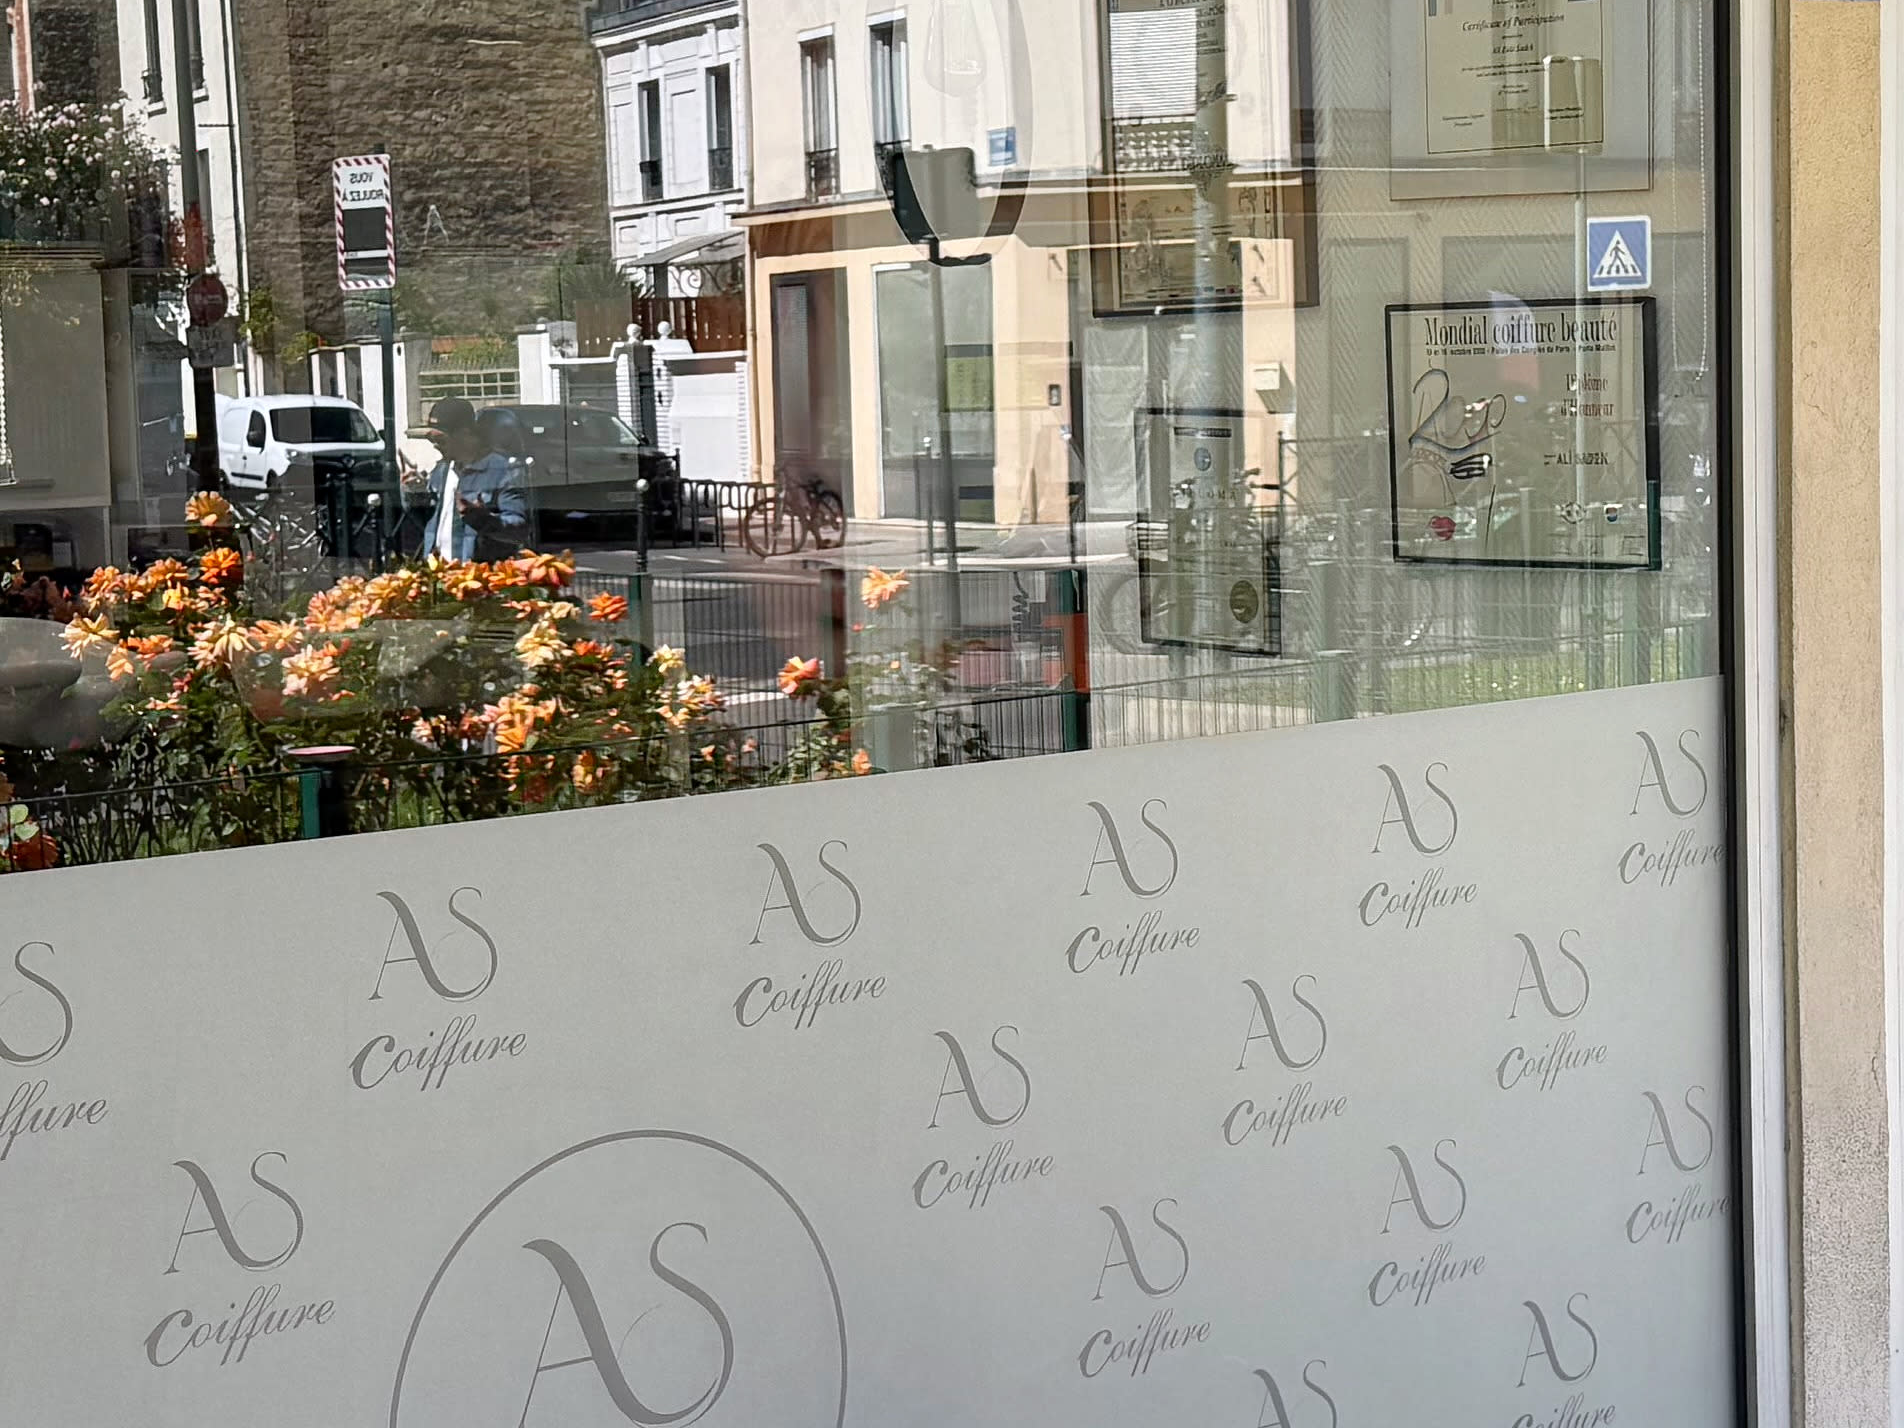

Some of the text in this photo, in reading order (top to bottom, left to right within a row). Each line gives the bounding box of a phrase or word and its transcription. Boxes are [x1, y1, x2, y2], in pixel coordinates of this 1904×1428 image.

[1424, 311, 1617, 346] Mondial coiffure beauté
[1371, 762, 1458, 854] AS
[1629, 729, 1708, 820] AS
[749, 840, 861, 945] AS
[1080, 799, 1178, 897] AS
[1618, 828, 1727, 888] Coiffure
[368, 886, 498, 1001] AS
[1065, 911, 1199, 976] Coiffure
[1357, 869, 1476, 929] Coiffure
[732, 959, 886, 1030] Coiffure
[1508, 929, 1590, 1020] AS
[348, 1015, 527, 1092] Coiffure
[1235, 975, 1327, 1071] AS
[1495, 1030, 1607, 1091] Coiffure
[927, 1025, 1031, 1129] AS
[1221, 1082, 1347, 1147] Coiffure
[912, 1140, 1053, 1210] Coiffure
[1637, 1085, 1714, 1176] AS
[163, 1151, 304, 1275] AS
[1381, 1139, 1467, 1234] AS
[1092, 1198, 1189, 1301] AS
[1367, 1242, 1485, 1307] Coiffure
[143, 1284, 335, 1368] Coiffure
[1077, 1309, 1210, 1379] Coiffure
[1517, 1292, 1598, 1388] AS
